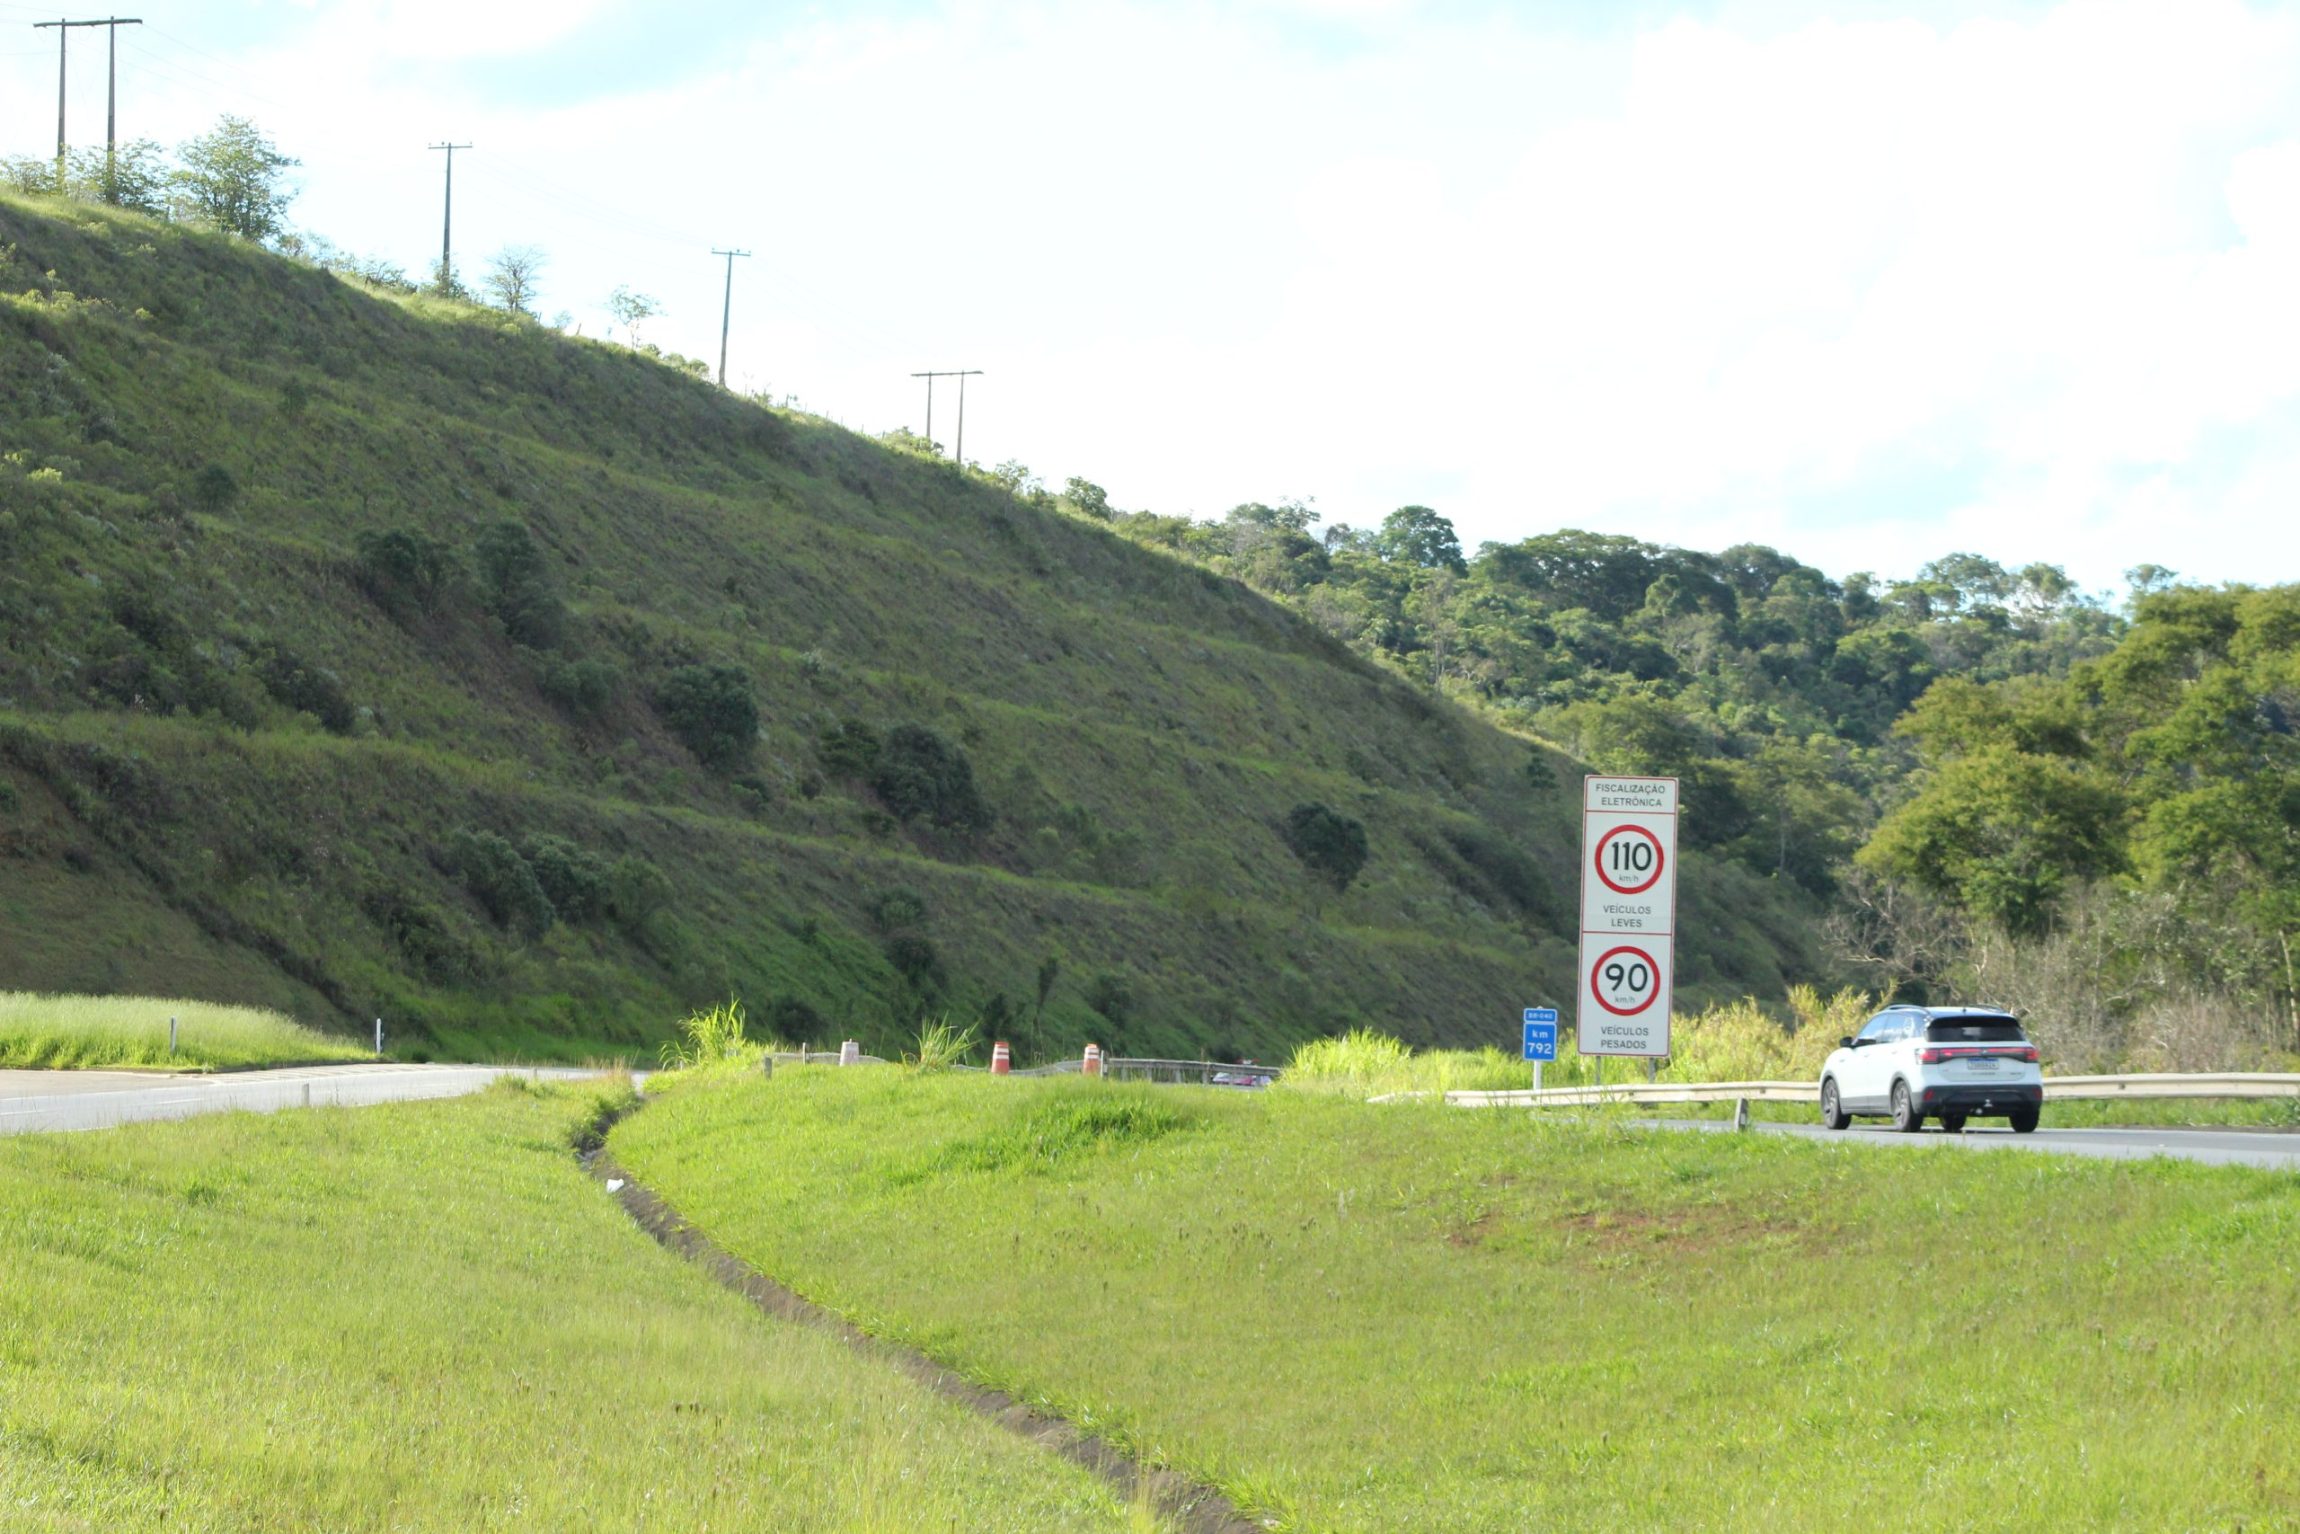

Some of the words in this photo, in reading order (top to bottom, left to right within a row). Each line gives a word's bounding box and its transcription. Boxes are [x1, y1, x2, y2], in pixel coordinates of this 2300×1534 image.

[1595, 783, 1666, 795] FISCALIZAÇÃO
[1601, 796, 1662, 807] ELETRÔNICA
[1611, 841, 1652, 871] 110
[1618, 873, 1639, 883] km/h
[1603, 904, 1651, 915] VEÍCULOS
[1611, 918, 1642, 928] LEVES
[1605, 963, 1648, 992] 90
[1614, 995, 1635, 1004] km/h
[1532, 1029, 1548, 1038] km
[1600, 1026, 1649, 1037] VEÍCULOS
[1527, 1042, 1552, 1055] 792
[1600, 1039, 1647, 1050] PESADOS
